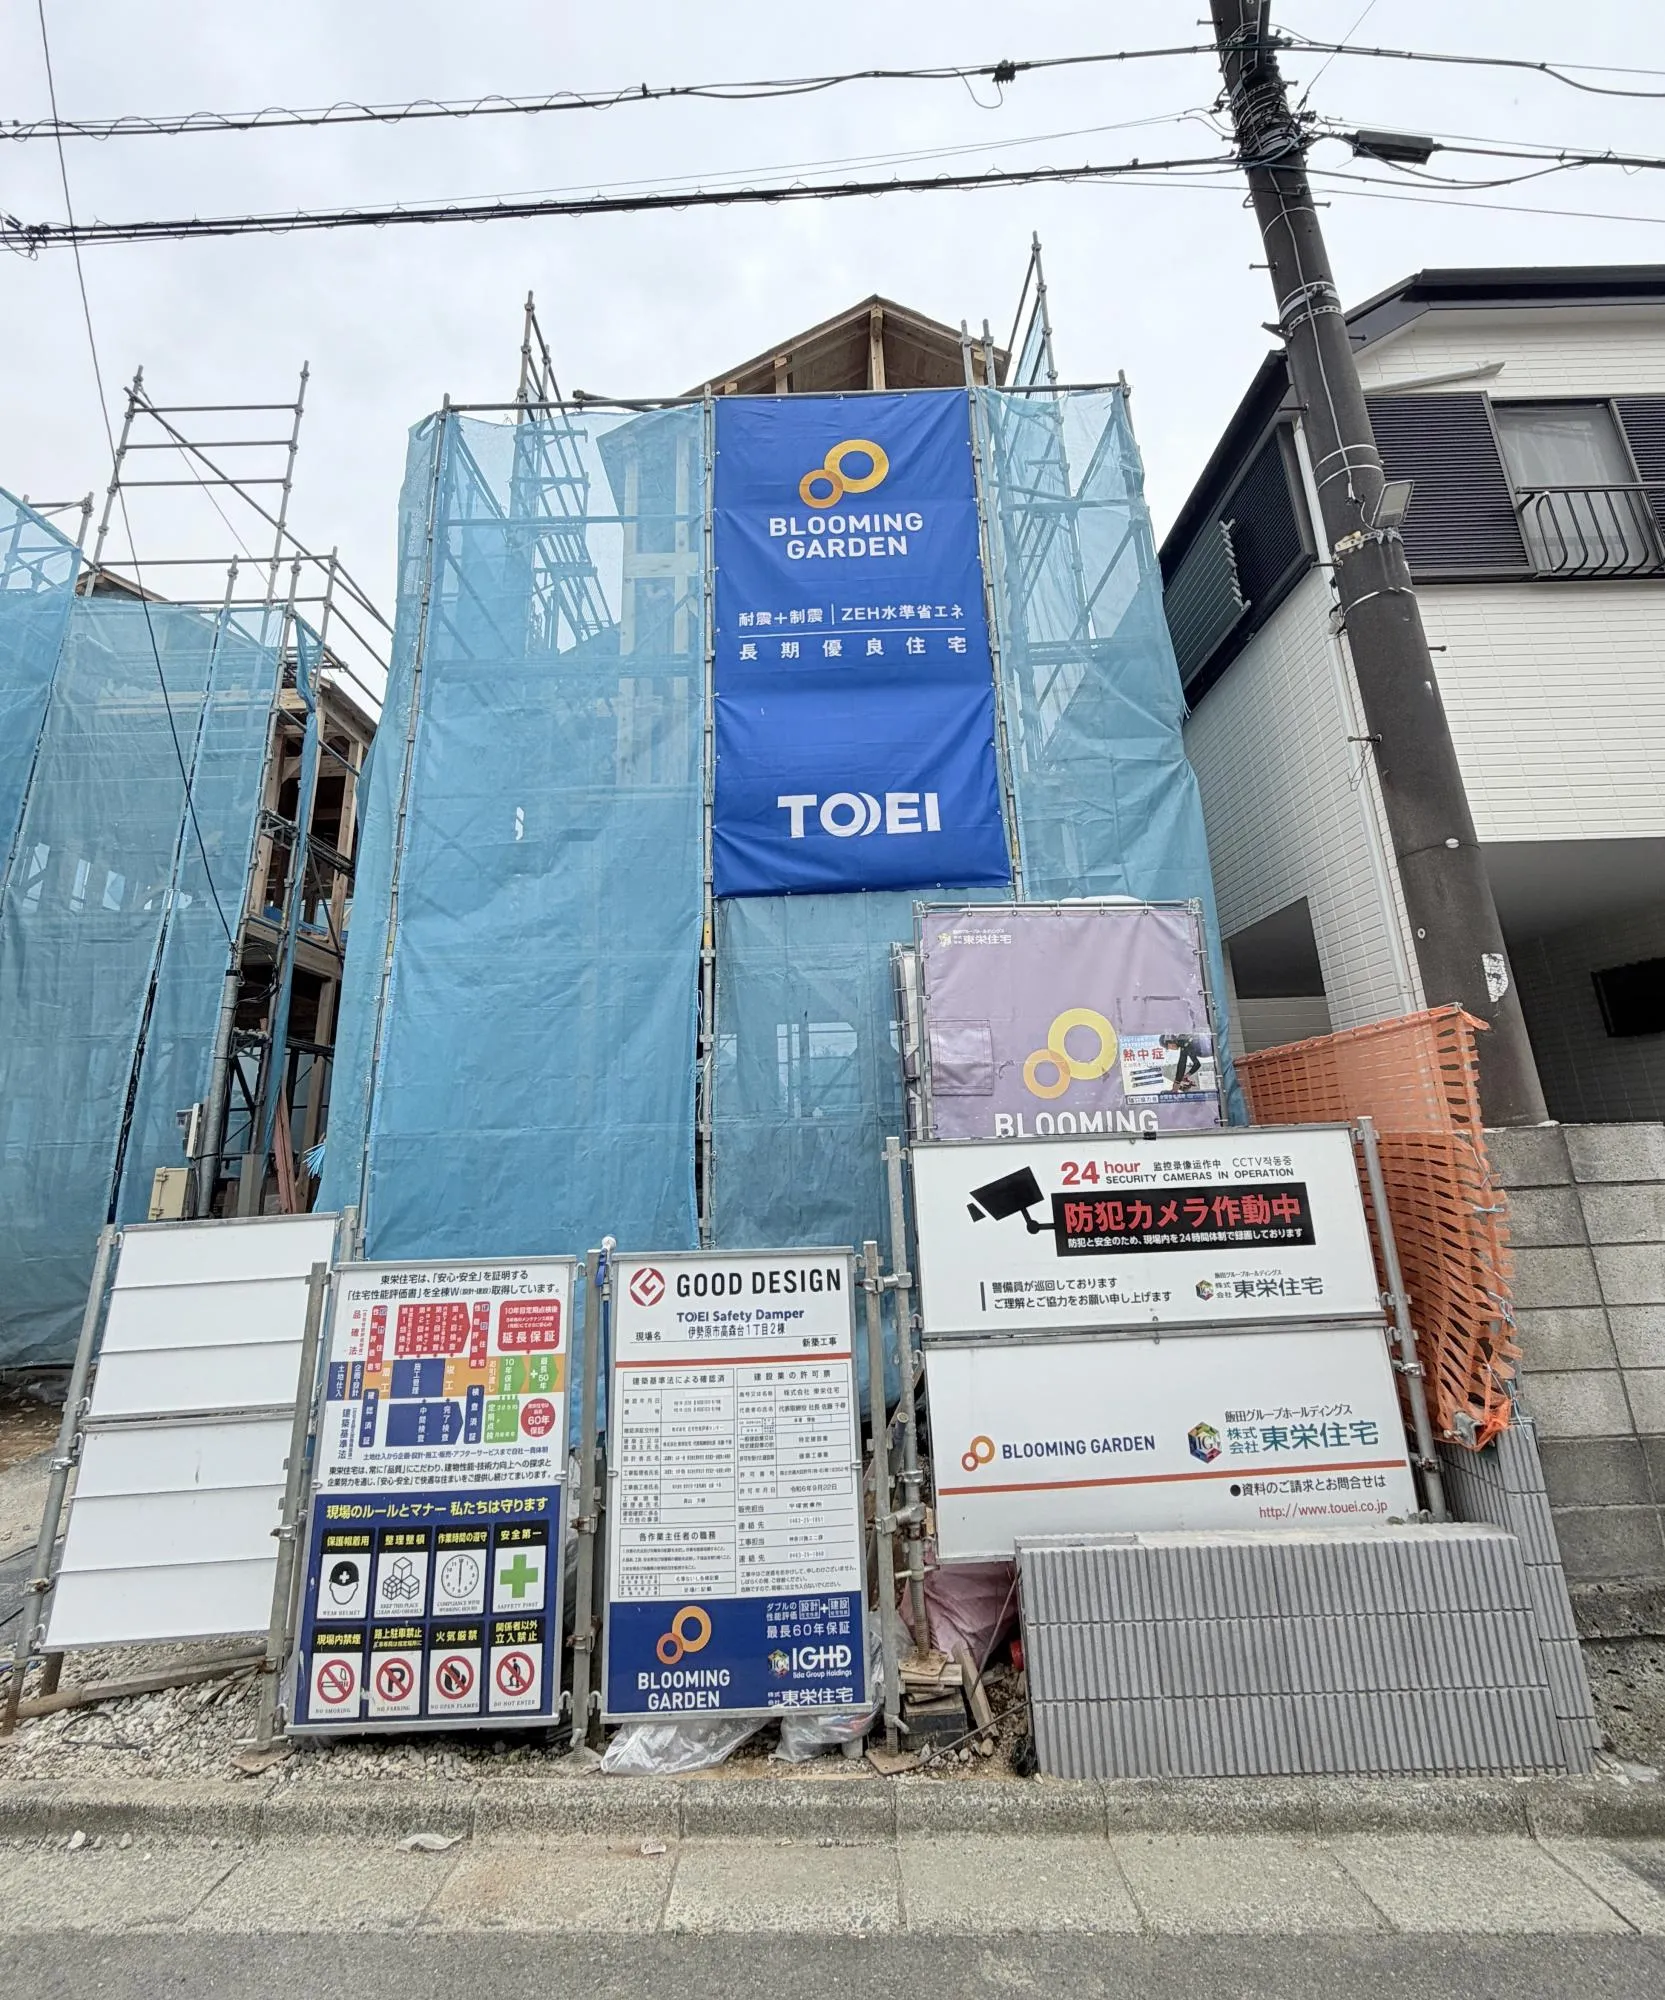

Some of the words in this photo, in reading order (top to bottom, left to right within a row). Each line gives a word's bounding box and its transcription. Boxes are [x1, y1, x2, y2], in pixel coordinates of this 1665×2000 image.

[769, 512, 923, 537] BLOOMING
[787, 537, 908, 559] GARDEN
[841, 604, 965, 622] ZEH水準省エネ
[739, 638, 967, 661] 長期優良住宅
[777, 792, 941, 838] TOEI
[1123, 1048, 1164, 1061] 熱中症
[994, 1110, 1158, 1137] BLOOMING
[1153, 1158, 1222, 1172] 监控录像运作中
[1232, 1156, 1293, 1168] CCTV작동중
[1061, 1161, 1100, 1185] 24
[1104, 1161, 1141, 1174] hour
[1106, 1174, 1157, 1185] SECURITY
[1163, 1172, 1213, 1182] CAMERAS
[1218, 1171, 1229, 1180] IN
[1234, 1168, 1294, 1179] OPERATION
[1064, 1193, 1301, 1234] 防犯カメラ作動中
[1068, 1228, 1303, 1248] 防犯と安全のため、現場内を24時間体制で録画しております
[677, 1273, 742, 1298] GOOD
[752, 1269, 841, 1294] DESIGN
[992, 1277, 1118, 1294] 警備員が巡回しております
[1233, 1277, 1323, 1298] 東栄住宅
[993, 1291, 1172, 1310] ご理解とご協力をお願い申し上げます
[676, 1311, 709, 1323] TOEI
[713, 1310, 752, 1323] Safety
[755, 1309, 804, 1322] Damper
[502, 1330, 555, 1344] 延長保証
[635, 1331, 662, 1341] 現場名
[802, 1337, 837, 1348] 新築工事
[632, 1374, 725, 1385] 建築基準法による確認済
[754, 1370, 831, 1381] 建設業の許可票
[528, 1415, 550, 1425] 60年
[1225, 1404, 1352, 1423] 飯田グループホールディングス
[1259, 1420, 1379, 1452] 東栄住宅
[1002, 1440, 1086, 1460] BLOOMING
[1091, 1435, 1156, 1454] GARDEN
[326, 1504, 446, 1520] 現場のルールとマナー
[451, 1497, 548, 1517] 私たちは守ります
[1259, 1499, 1388, 1519] http://www.touei.co.jp
[385, 1534, 425, 1546] 整理整頓
[501, 1528, 542, 1541] 安全第一
[640, 1531, 716, 1541] 各作業主任者の職務
[767, 1602, 797, 1611] ダブルの
[801, 1602, 818, 1612] 設計
[830, 1599, 848, 1610] 建設
[766, 1612, 797, 1621] 性能評価
[495, 1620, 538, 1631] 関係者以外
[767, 1621, 850, 1639] 最長60年保証
[317, 1633, 361, 1645] 現場内禁煙
[436, 1630, 478, 1642] 火気厳禁
[495, 1630, 538, 1643] 立入禁止
[638, 1669, 730, 1690] BLOOMING
[806, 1670, 825, 1679] Group
[826, 1669, 852, 1678] Holdings
[648, 1691, 720, 1710] GARDEN
[782, 1687, 853, 1708] 東栄住宅
